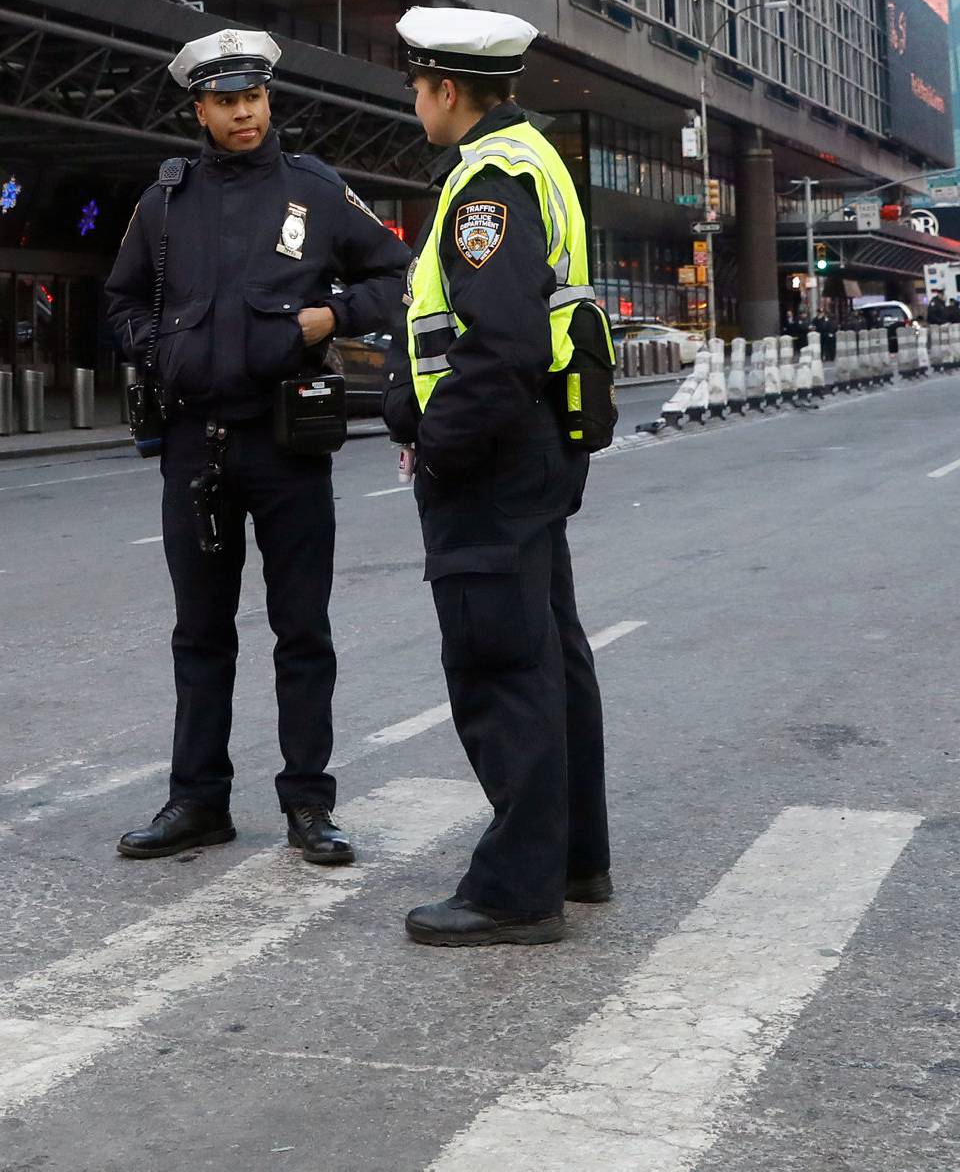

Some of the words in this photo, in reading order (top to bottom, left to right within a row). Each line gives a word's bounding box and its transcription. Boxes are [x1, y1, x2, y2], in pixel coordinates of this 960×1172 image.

[465, 204, 496, 213] TRAFFIC
[467, 214, 492, 222] POLICE
[460, 220, 499, 230] DEPARTMENT
[458, 237, 467, 250] CITY
[465, 250, 472, 258] OF
[480, 248, 491, 260] NEW
[490, 233, 500, 248] YORK
